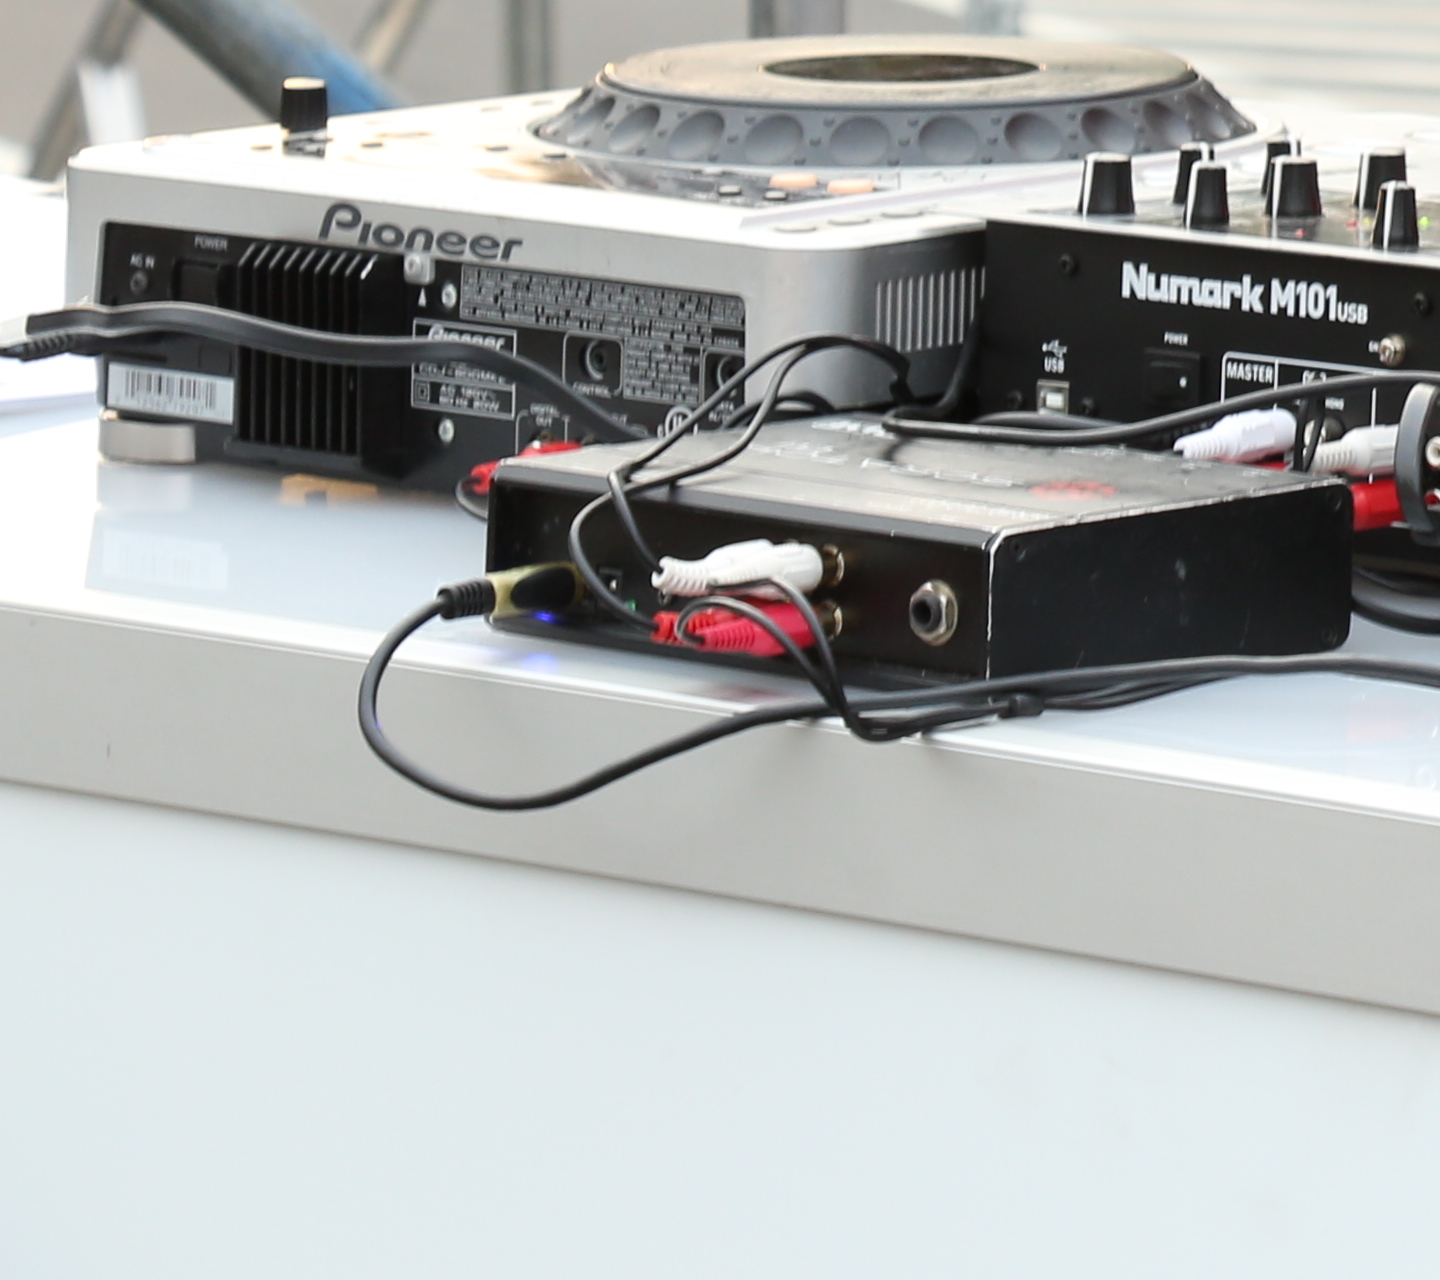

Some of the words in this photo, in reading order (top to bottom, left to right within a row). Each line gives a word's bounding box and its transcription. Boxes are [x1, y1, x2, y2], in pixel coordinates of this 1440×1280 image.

[318, 202, 523, 262] Pioneer
[1121, 260, 1264, 314] Numark
[1044, 356, 1065, 374] USB
[1226, 360, 1274, 384] MASTER
